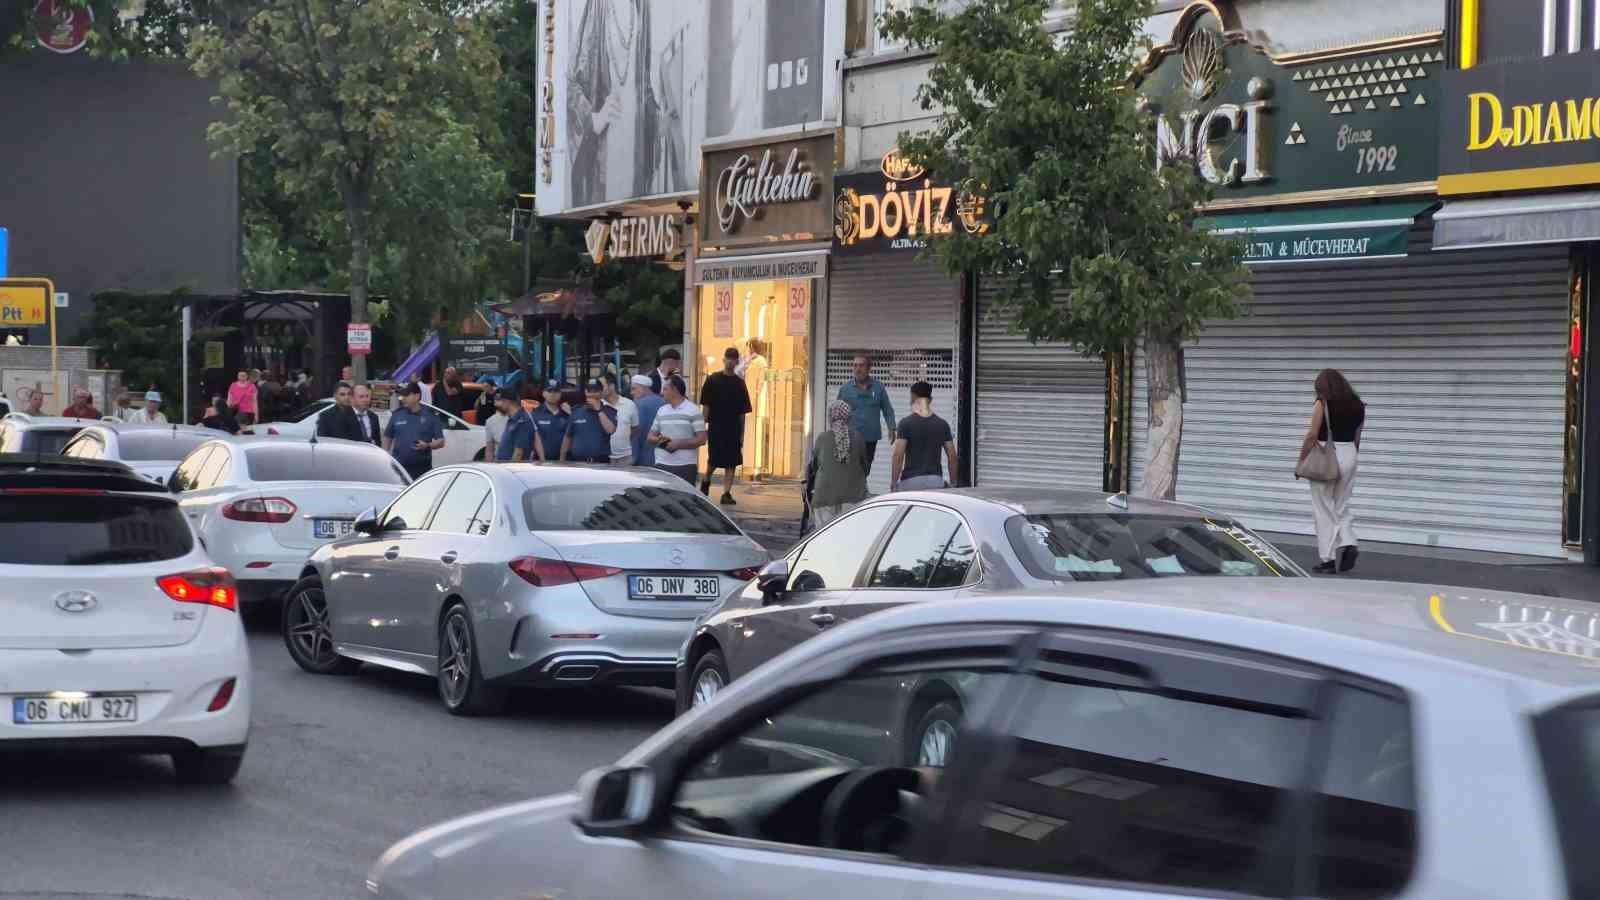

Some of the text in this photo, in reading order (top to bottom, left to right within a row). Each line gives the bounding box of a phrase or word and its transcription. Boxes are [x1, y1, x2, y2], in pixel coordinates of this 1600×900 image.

[1336, 124, 1373, 151] Since
[1355, 146, 1398, 173] 1992
[716, 147, 815, 232] Gültekin
[858, 179, 953, 238] DÖVİZ
[608, 214, 674, 259] SETRMS
[1279, 241, 1288, 257] &
[1292, 237, 1371, 256] MÜCEVHERAT
[717, 290, 731, 312] 30
[790, 286, 806, 309] 30
[2, 304, 23, 321] Ptt
[637, 578, 717, 594] 06 DNV 380
[26, 699, 133, 720] 06 CMU 927
